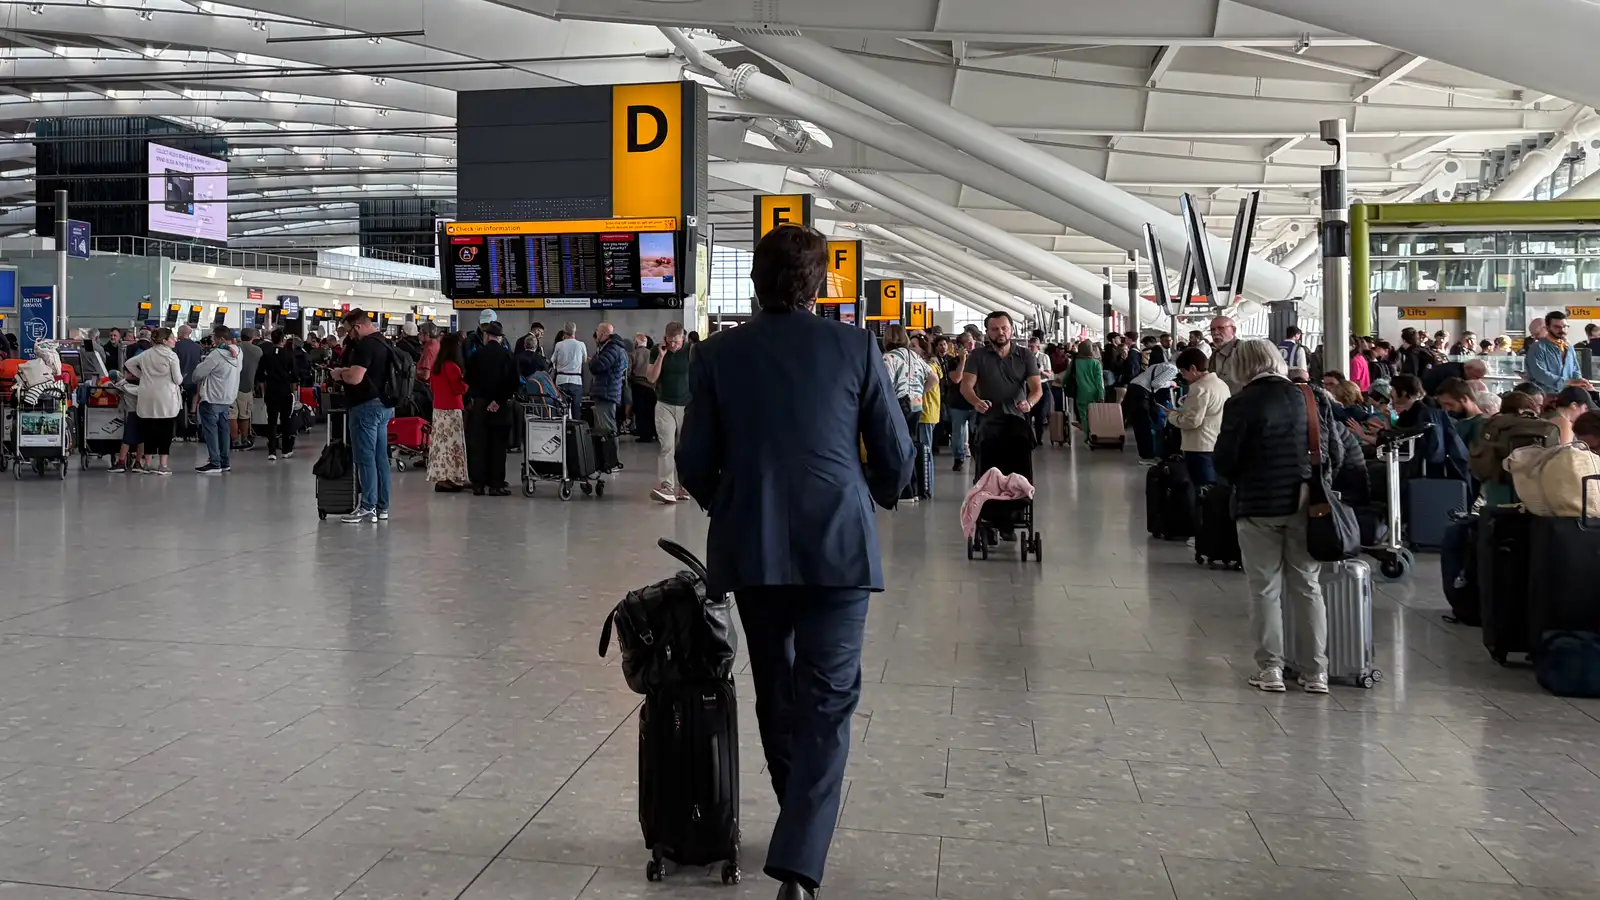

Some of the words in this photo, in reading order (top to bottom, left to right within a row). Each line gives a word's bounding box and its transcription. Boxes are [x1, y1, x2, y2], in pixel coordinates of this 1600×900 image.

[626, 104, 668, 153] D
[835, 249, 847, 270] F
[884, 285, 897, 299] G
[913, 305, 922, 315] H
[1407, 308, 1427, 316] Lifts
[1572, 308, 1590, 316] Lifts
